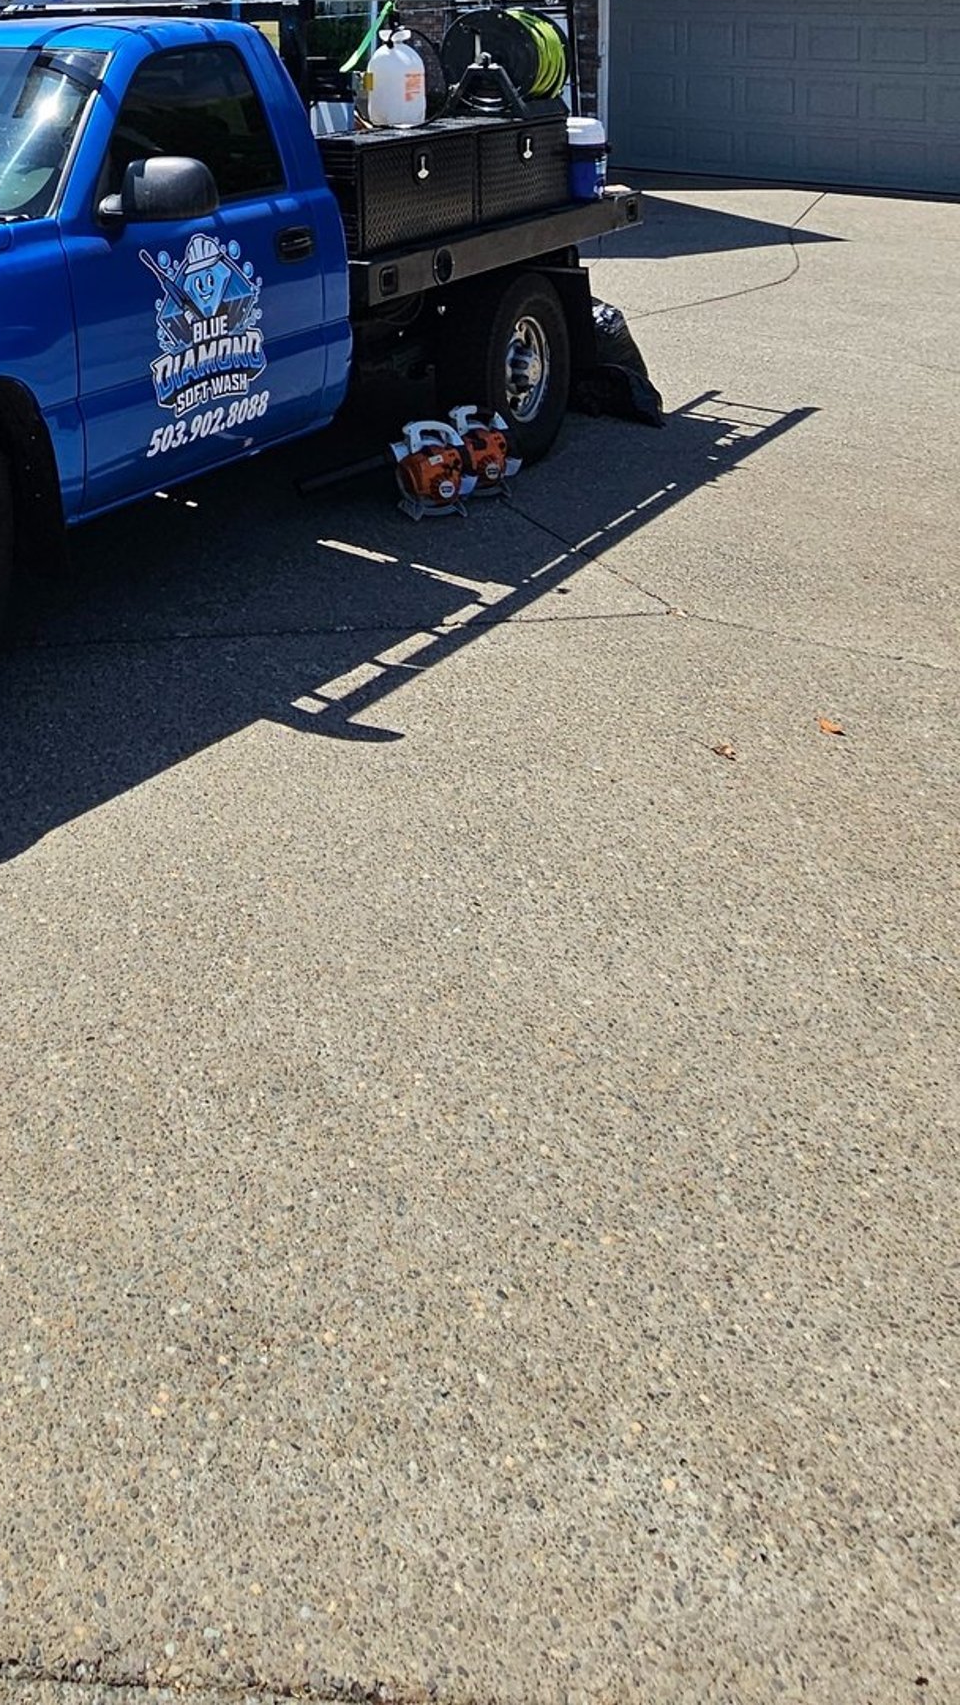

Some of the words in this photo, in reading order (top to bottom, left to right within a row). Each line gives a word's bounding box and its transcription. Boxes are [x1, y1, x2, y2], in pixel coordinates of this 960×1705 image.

[193, 315, 228, 344] BLUE
[154, 331, 263, 401] DIAMOND
[177, 380, 209, 413] SOFT
[211, 373, 247, 395] WASH
[146, 390, 269, 458] 503.902.8088
